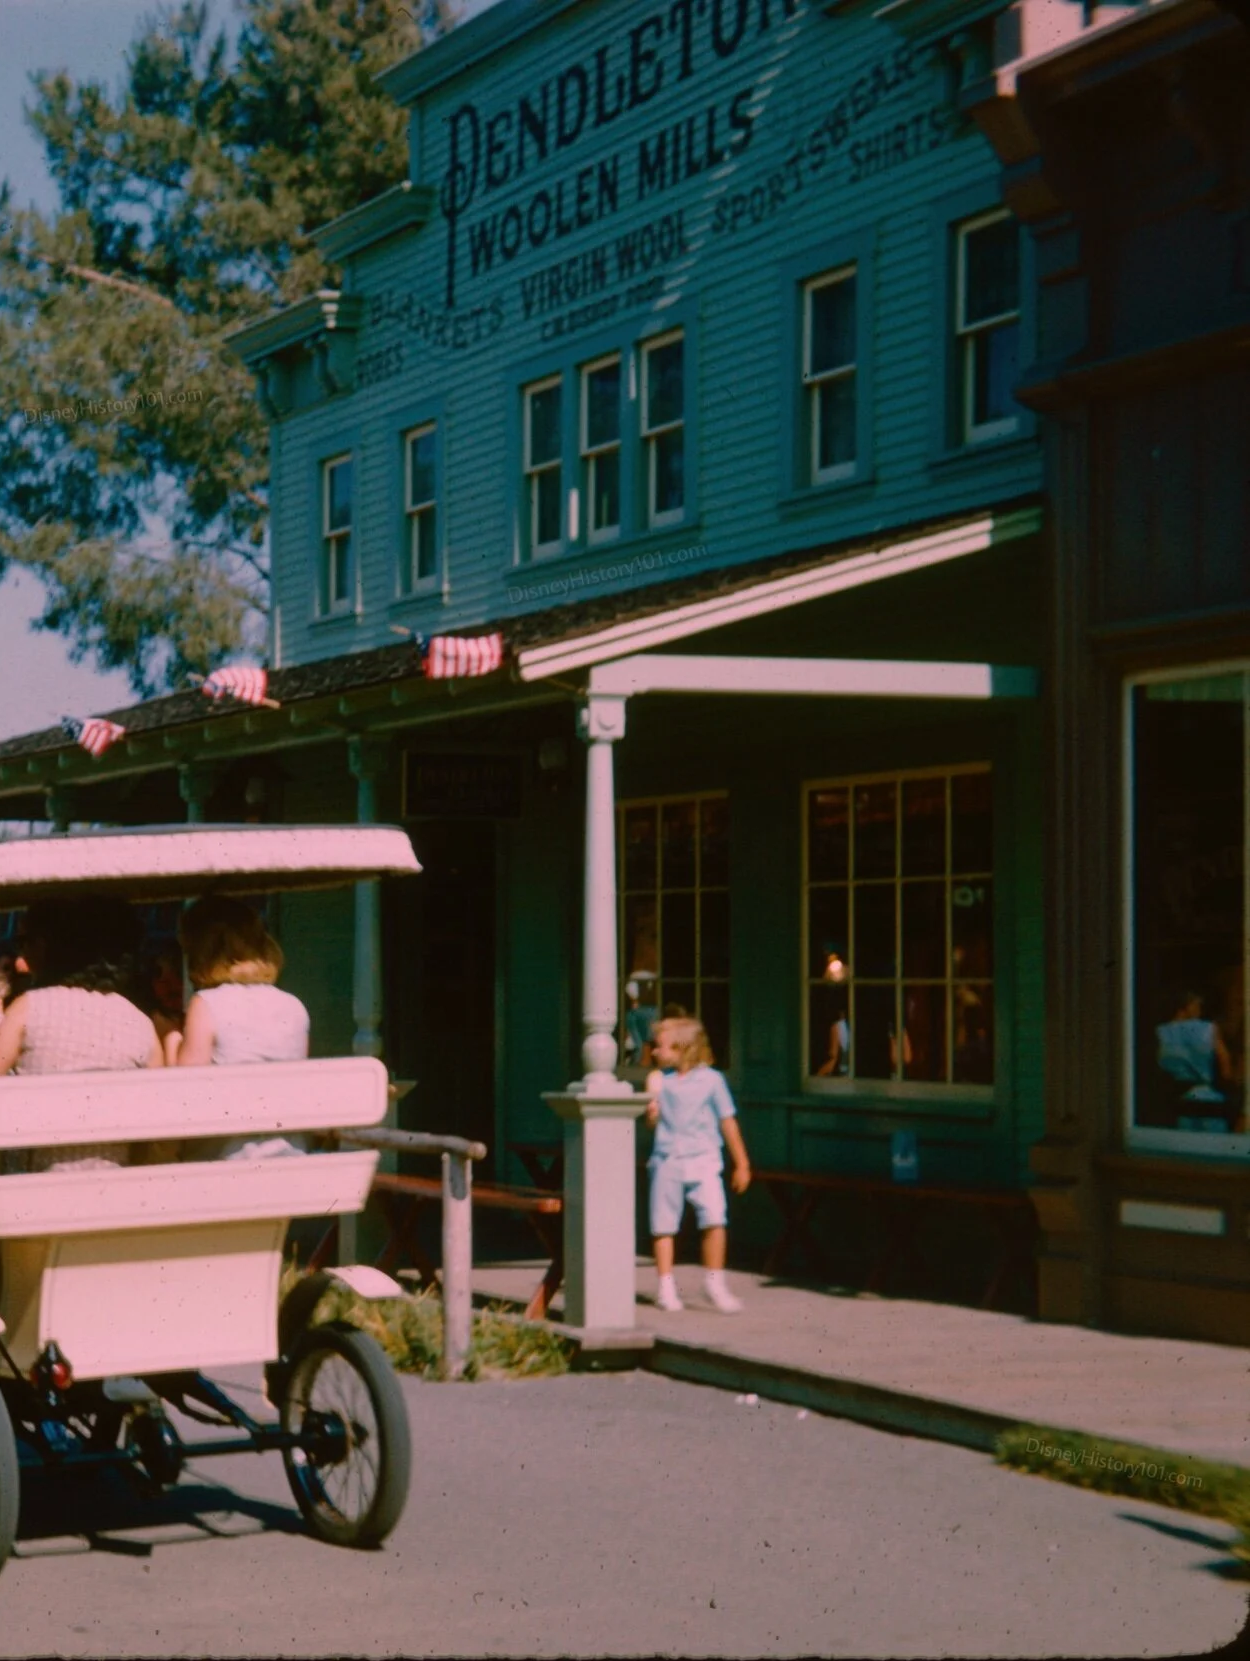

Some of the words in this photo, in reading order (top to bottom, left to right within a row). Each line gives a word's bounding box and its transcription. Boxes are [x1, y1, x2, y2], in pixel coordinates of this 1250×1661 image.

[469, 153, 620, 275] WOOLEN
[637, 88, 755, 201] MILLS
[850, 107, 944, 183] SHIRTS
[520, 241, 608, 321] VIRGIN
[614, 208, 687, 281] WOOL
